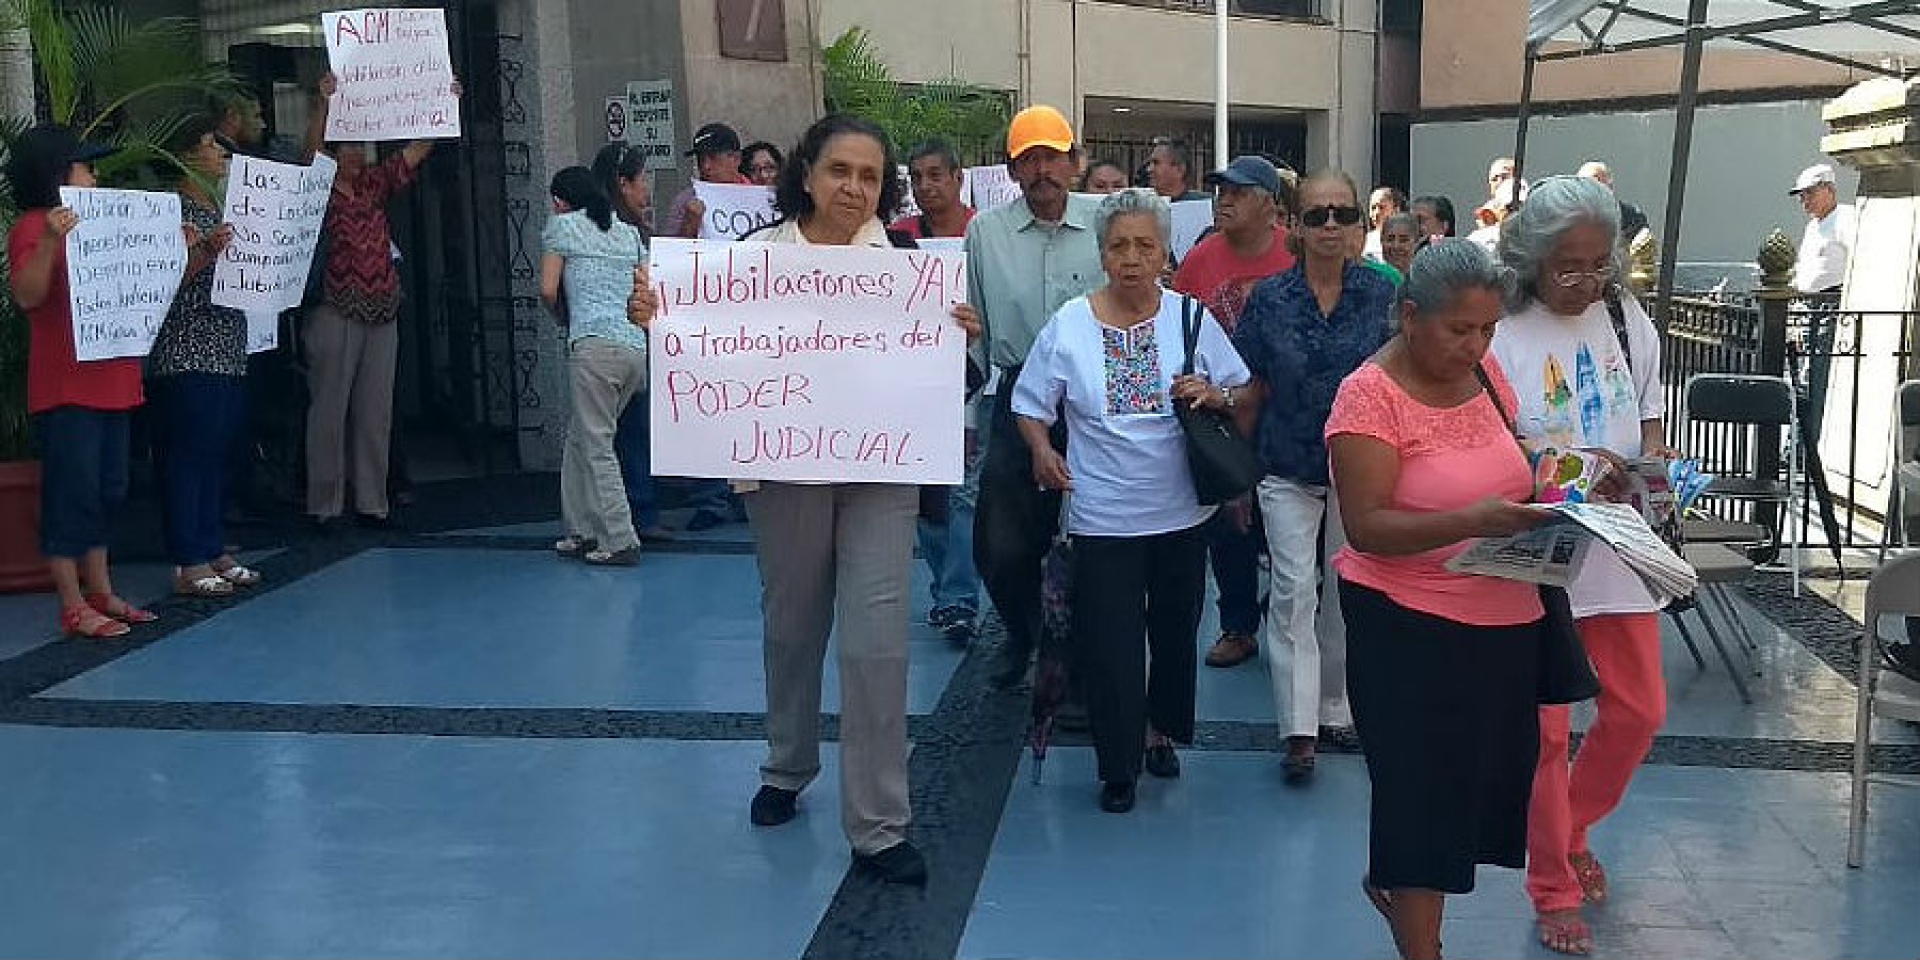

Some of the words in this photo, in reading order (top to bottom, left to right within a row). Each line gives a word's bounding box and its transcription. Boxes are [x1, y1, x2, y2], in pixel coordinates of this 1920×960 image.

[336, 10, 390, 47] ACM
[243, 161, 281, 190] Las
[232, 195, 266, 218] de
[232, 225, 261, 244] No
[665, 333, 684, 357] a
[689, 319, 886, 360] trabajadores
[901, 319, 942, 350] del
[667, 370, 812, 423] PODER
